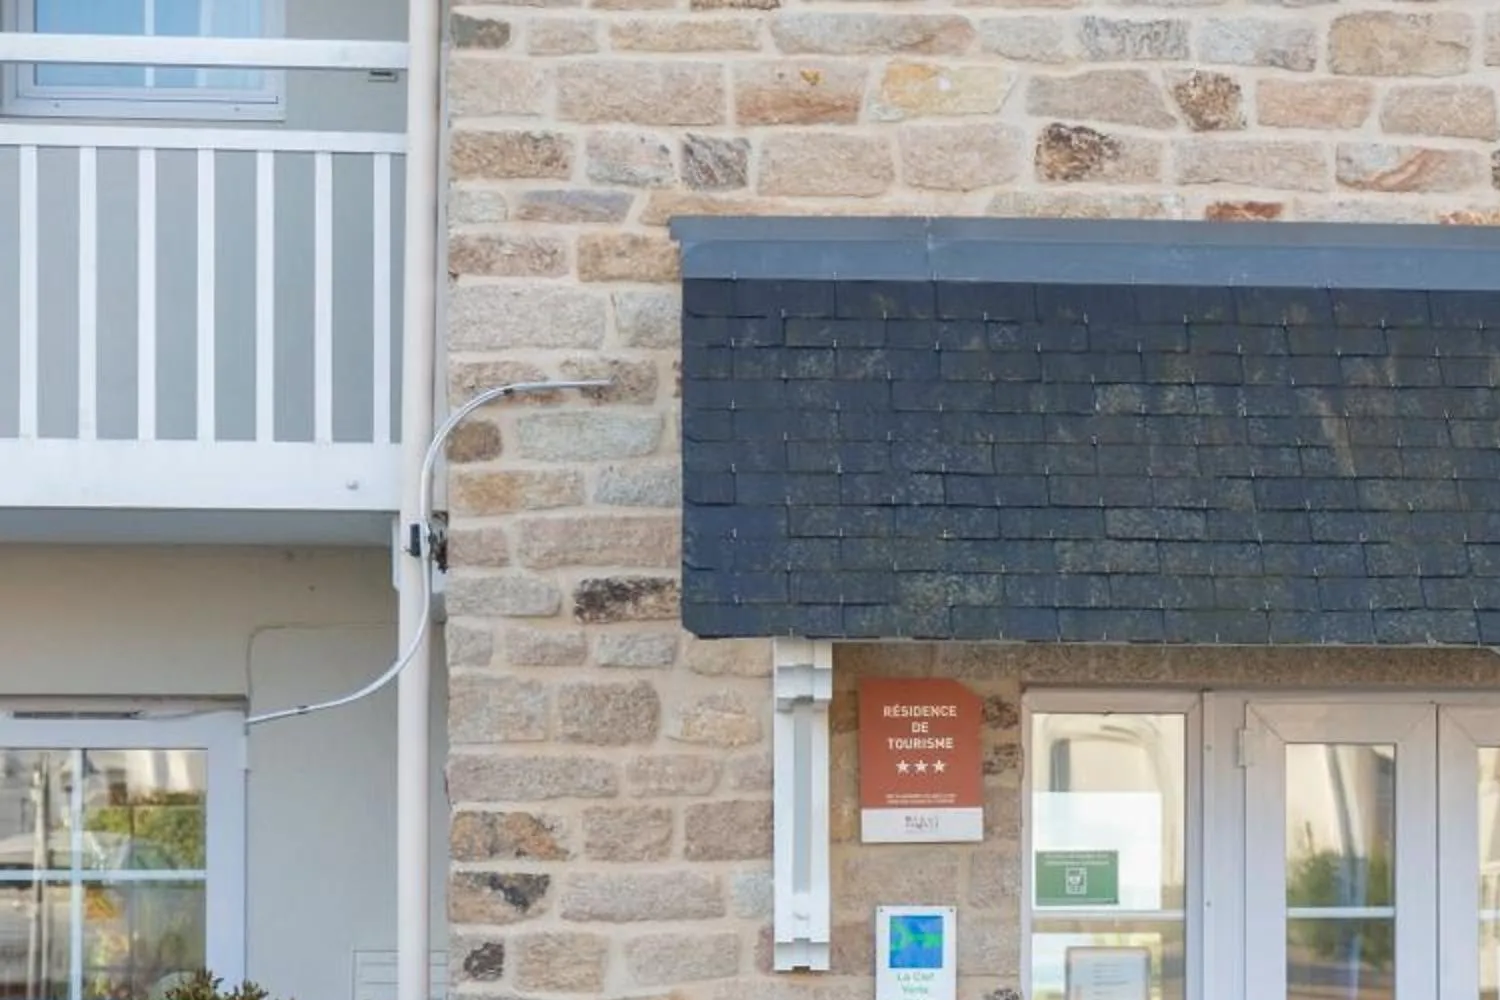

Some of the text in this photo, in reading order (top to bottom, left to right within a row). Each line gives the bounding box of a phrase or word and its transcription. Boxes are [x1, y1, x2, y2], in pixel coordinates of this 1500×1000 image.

[883, 704, 957, 718] RÉSIDENCE
[911, 721, 929, 733] DE
[887, 737, 954, 750] TOURISME
